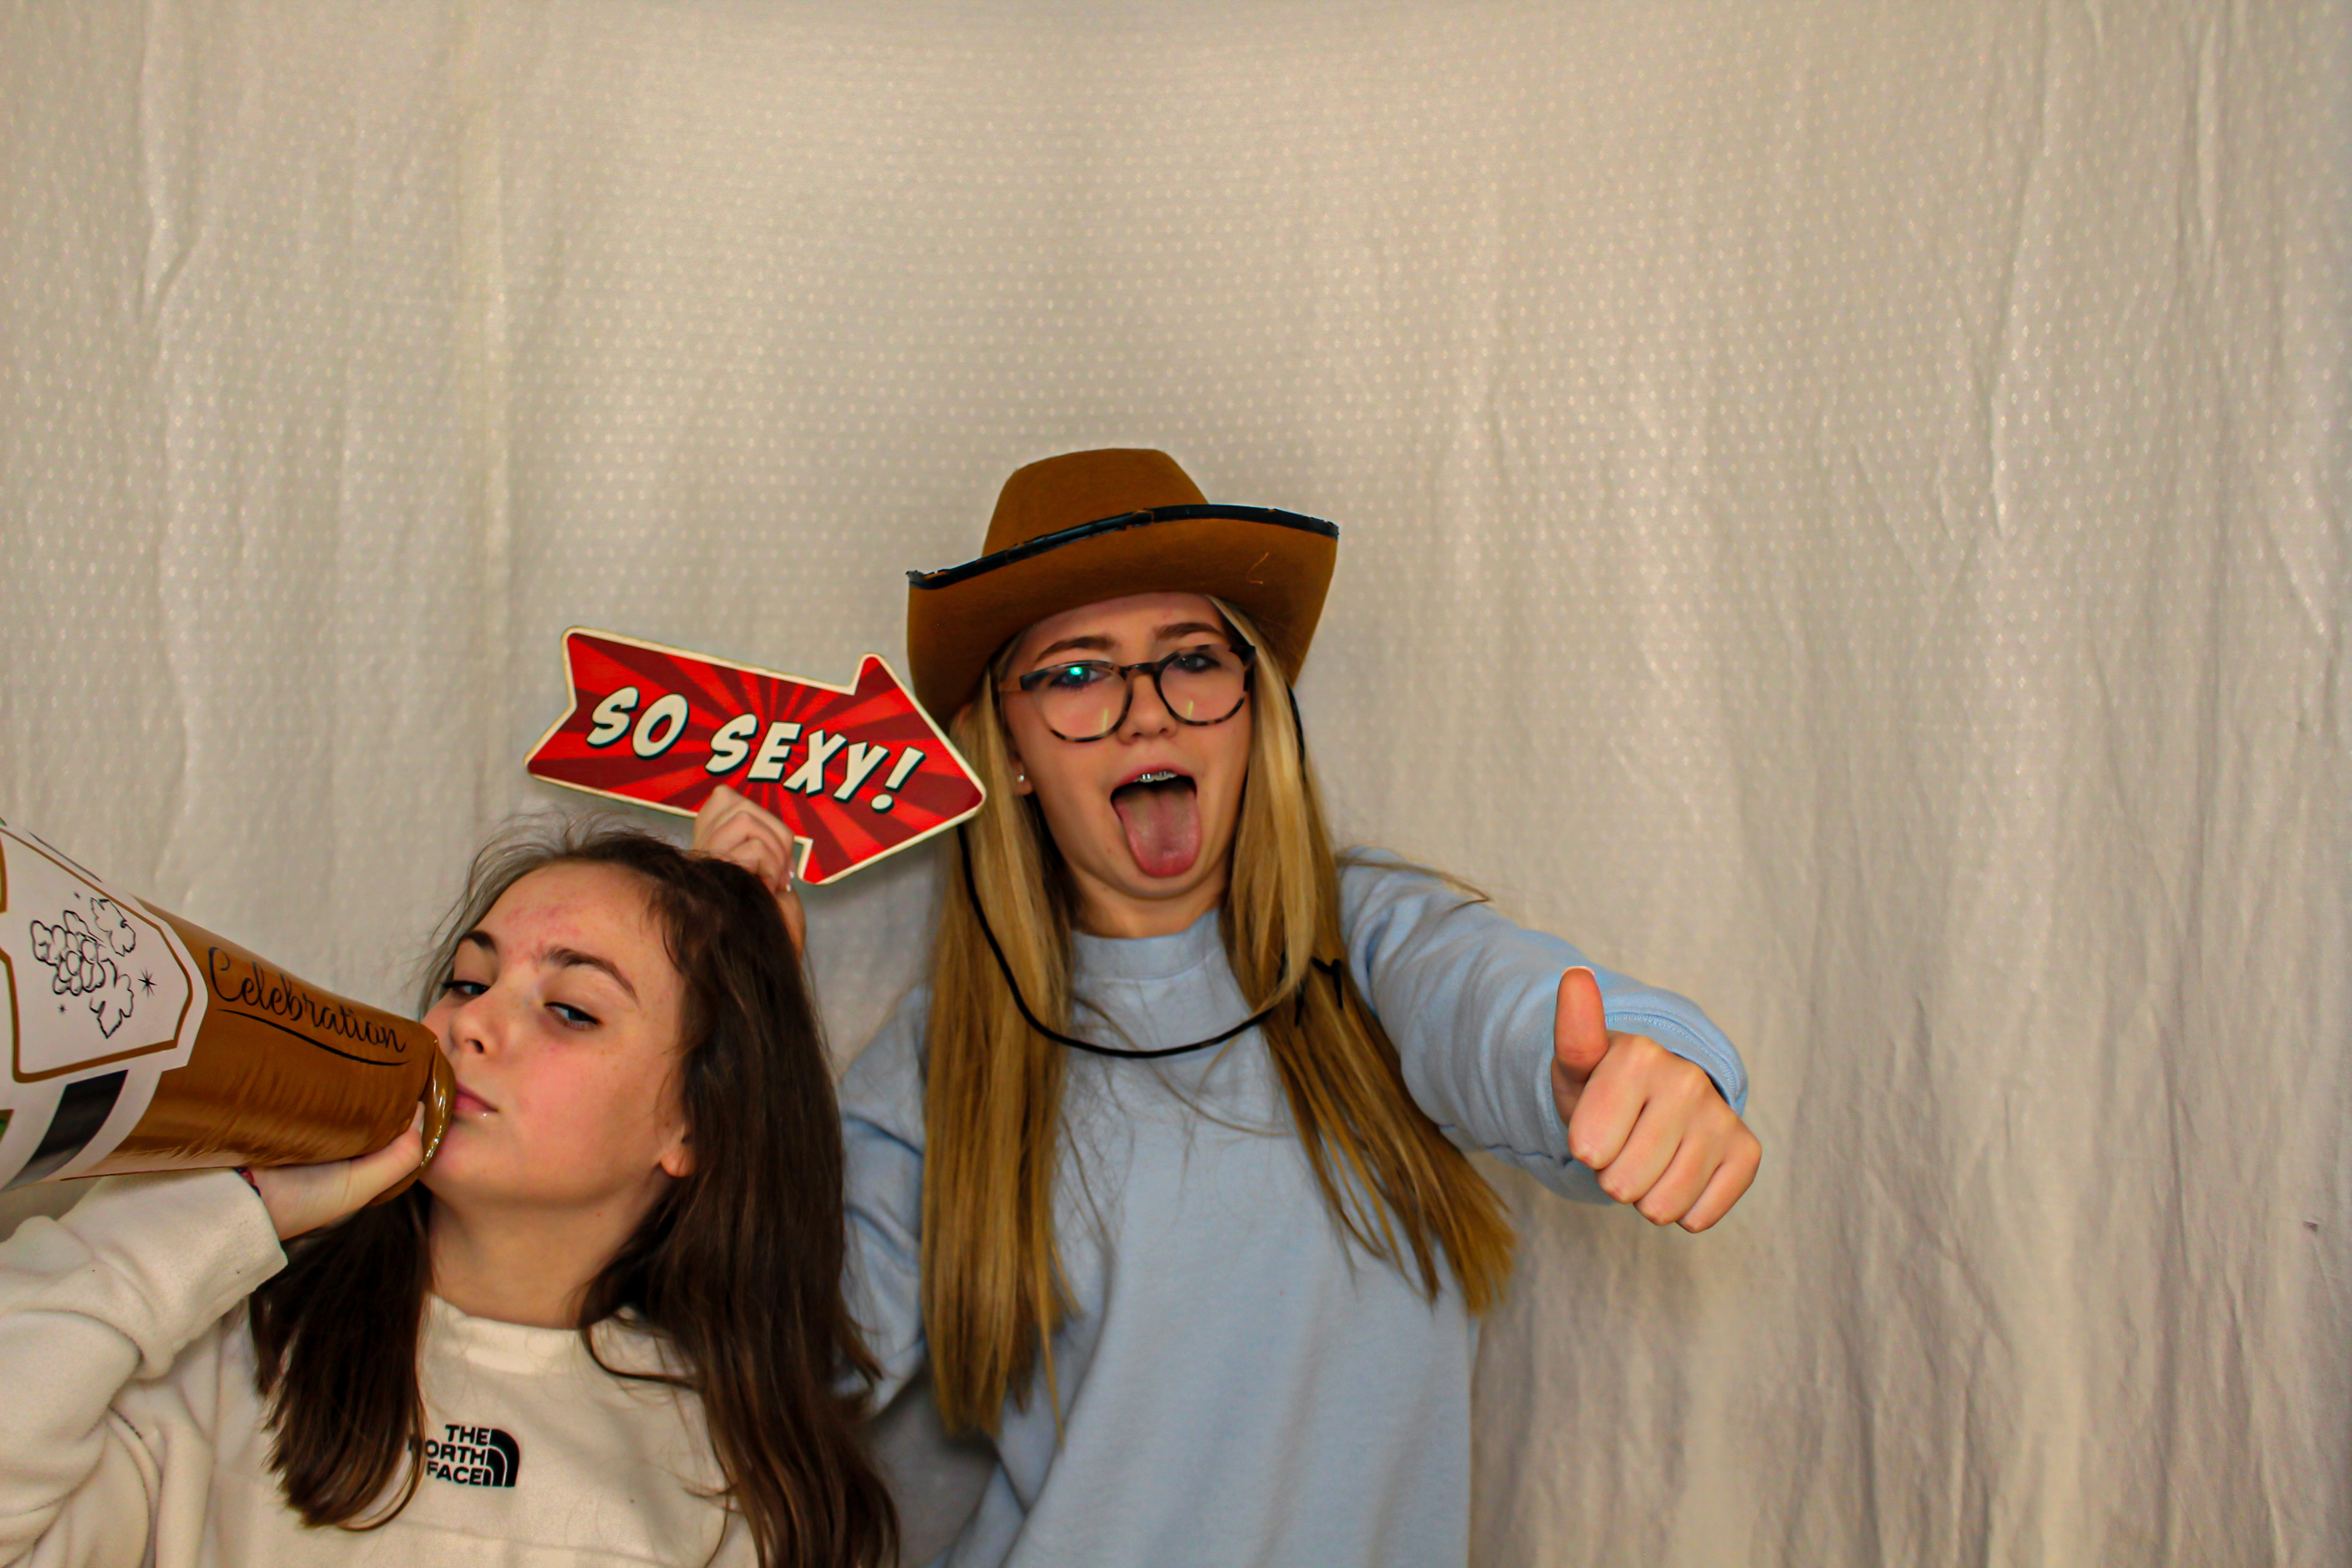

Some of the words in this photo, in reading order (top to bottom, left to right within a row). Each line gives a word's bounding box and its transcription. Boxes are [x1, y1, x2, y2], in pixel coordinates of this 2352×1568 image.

[586, 686, 689, 760] SO
[705, 713, 926, 813] SEXY!
[209, 946, 407, 1053] Celebration
[445, 1424, 490, 1446] THE
[408, 1436, 486, 1465] ORTH
[426, 1460, 484, 1485] FACE
